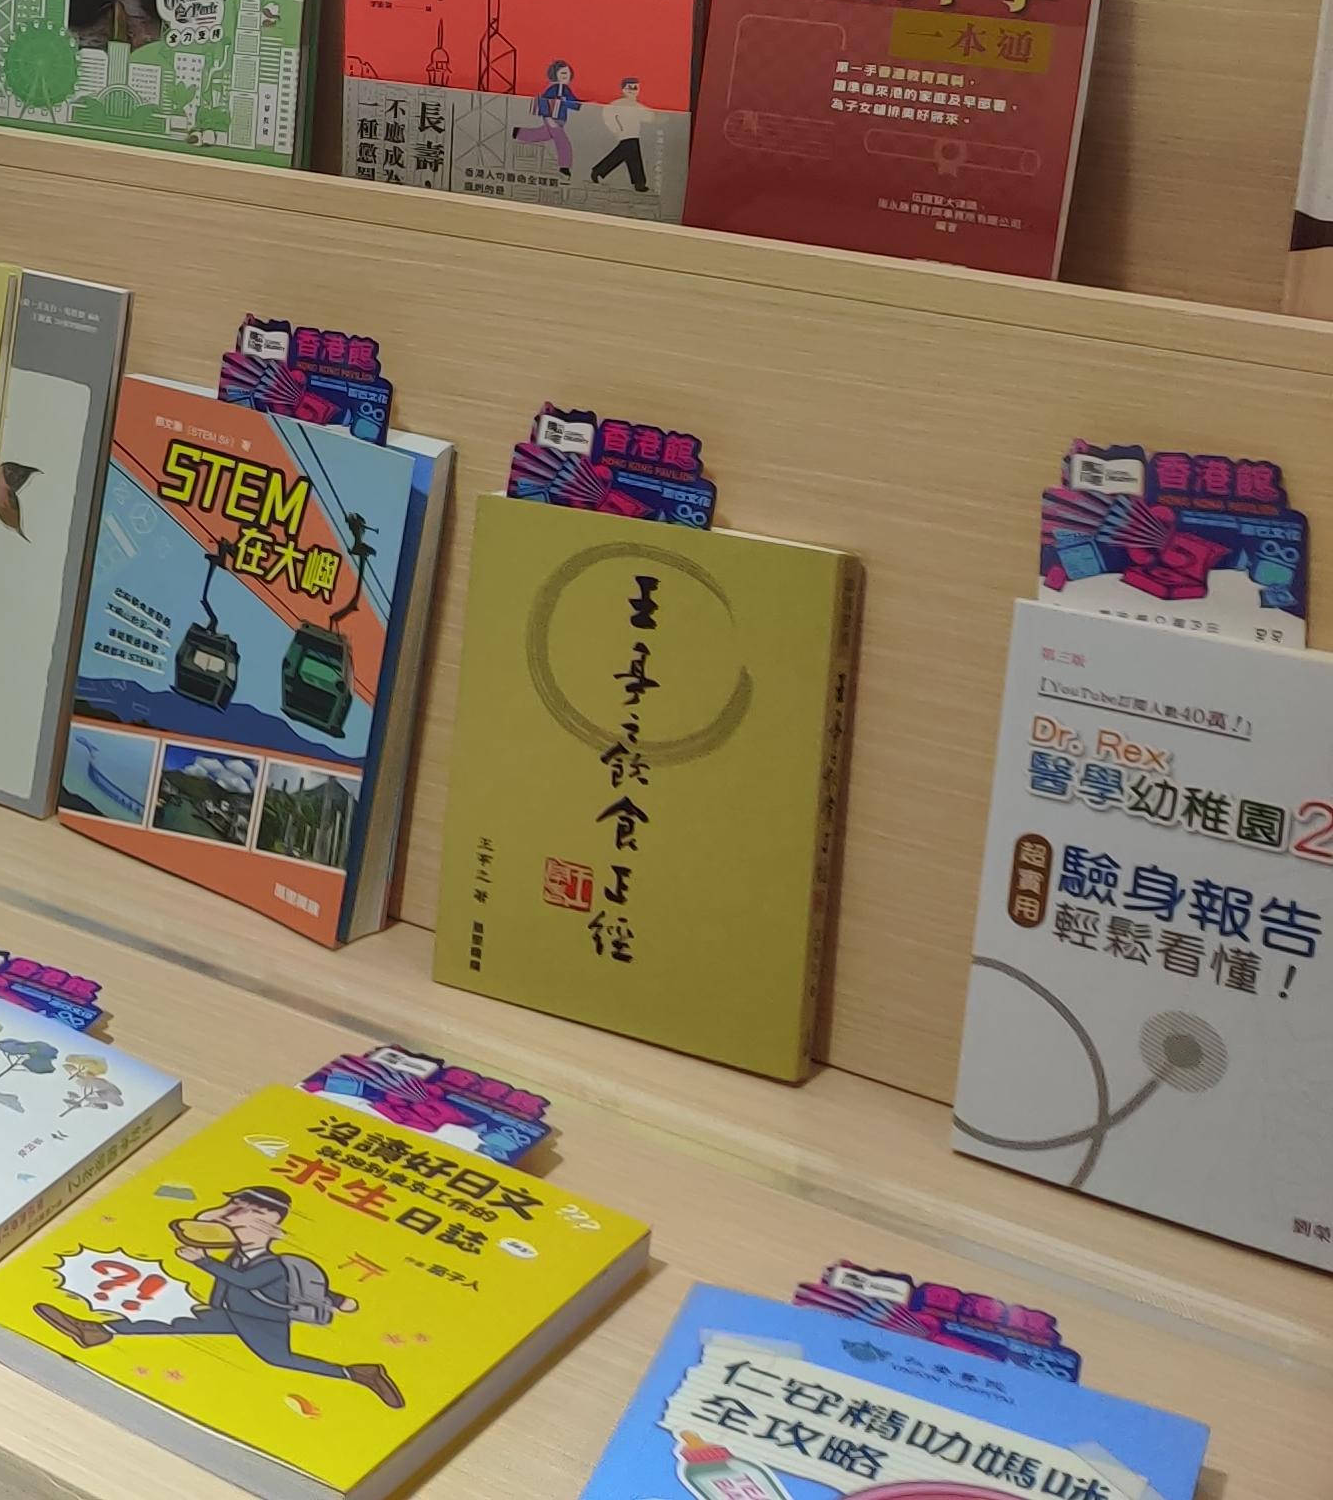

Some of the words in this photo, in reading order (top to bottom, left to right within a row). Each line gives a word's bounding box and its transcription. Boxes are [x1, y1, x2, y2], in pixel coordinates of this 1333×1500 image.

[905, 21, 1034, 64] 一本通
[295, 333, 381, 372] 香港館
[160, 442, 311, 536] STEM
[601, 423, 699, 469] 香港館
[1155, 454, 1280, 501] 香港館
[234, 525, 340, 599] 在大嶼
[1031, 715, 1081, 751] Dr.
[1096, 729, 1167, 772] Rex
[1058, 844, 1323, 958] 驗身報告
[1052, 901, 1298, 999] 輕鬆看懂！
[270, 1153, 489, 1255] 求生日誌
[307, 1115, 544, 1221] 沒讀好日文
[690, 1394, 889, 1481] 全攻略
[723, 1359, 1111, 1500] 仁安精叻媽咪
